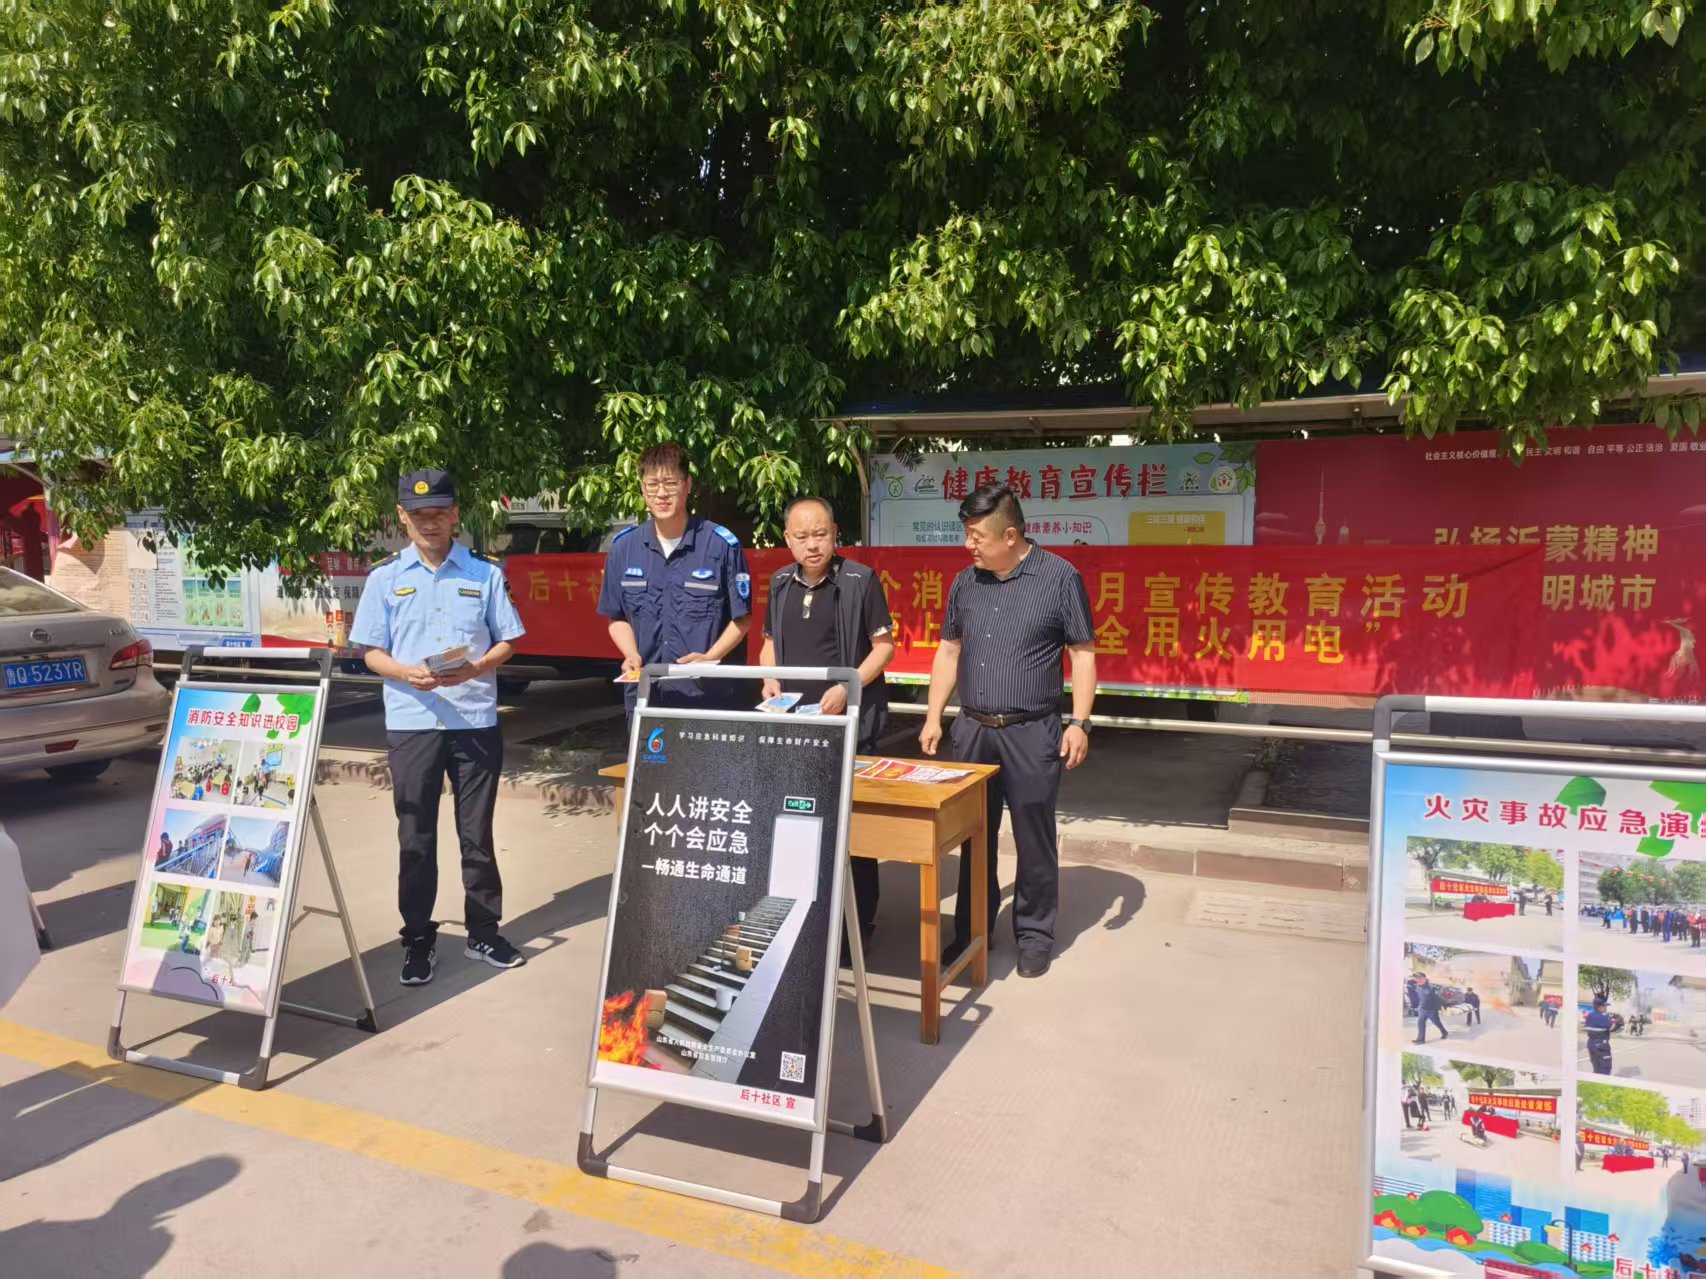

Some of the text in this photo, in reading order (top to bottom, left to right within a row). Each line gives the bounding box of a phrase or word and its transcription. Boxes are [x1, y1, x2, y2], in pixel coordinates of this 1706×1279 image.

[1541, 574, 1657, 612] 明城市
[188, 710, 298, 730] 消防安全知识进校园
[679, 731, 830, 748] 学习应急科普知识 保障生命财产安全
[646, 792, 753, 825] 人人讲安全
[1424, 795, 1706, 839] 火灾事故应急演
[643, 823, 750, 854] 个个会应急
[741, 1089, 781, 1106] 后十社区
